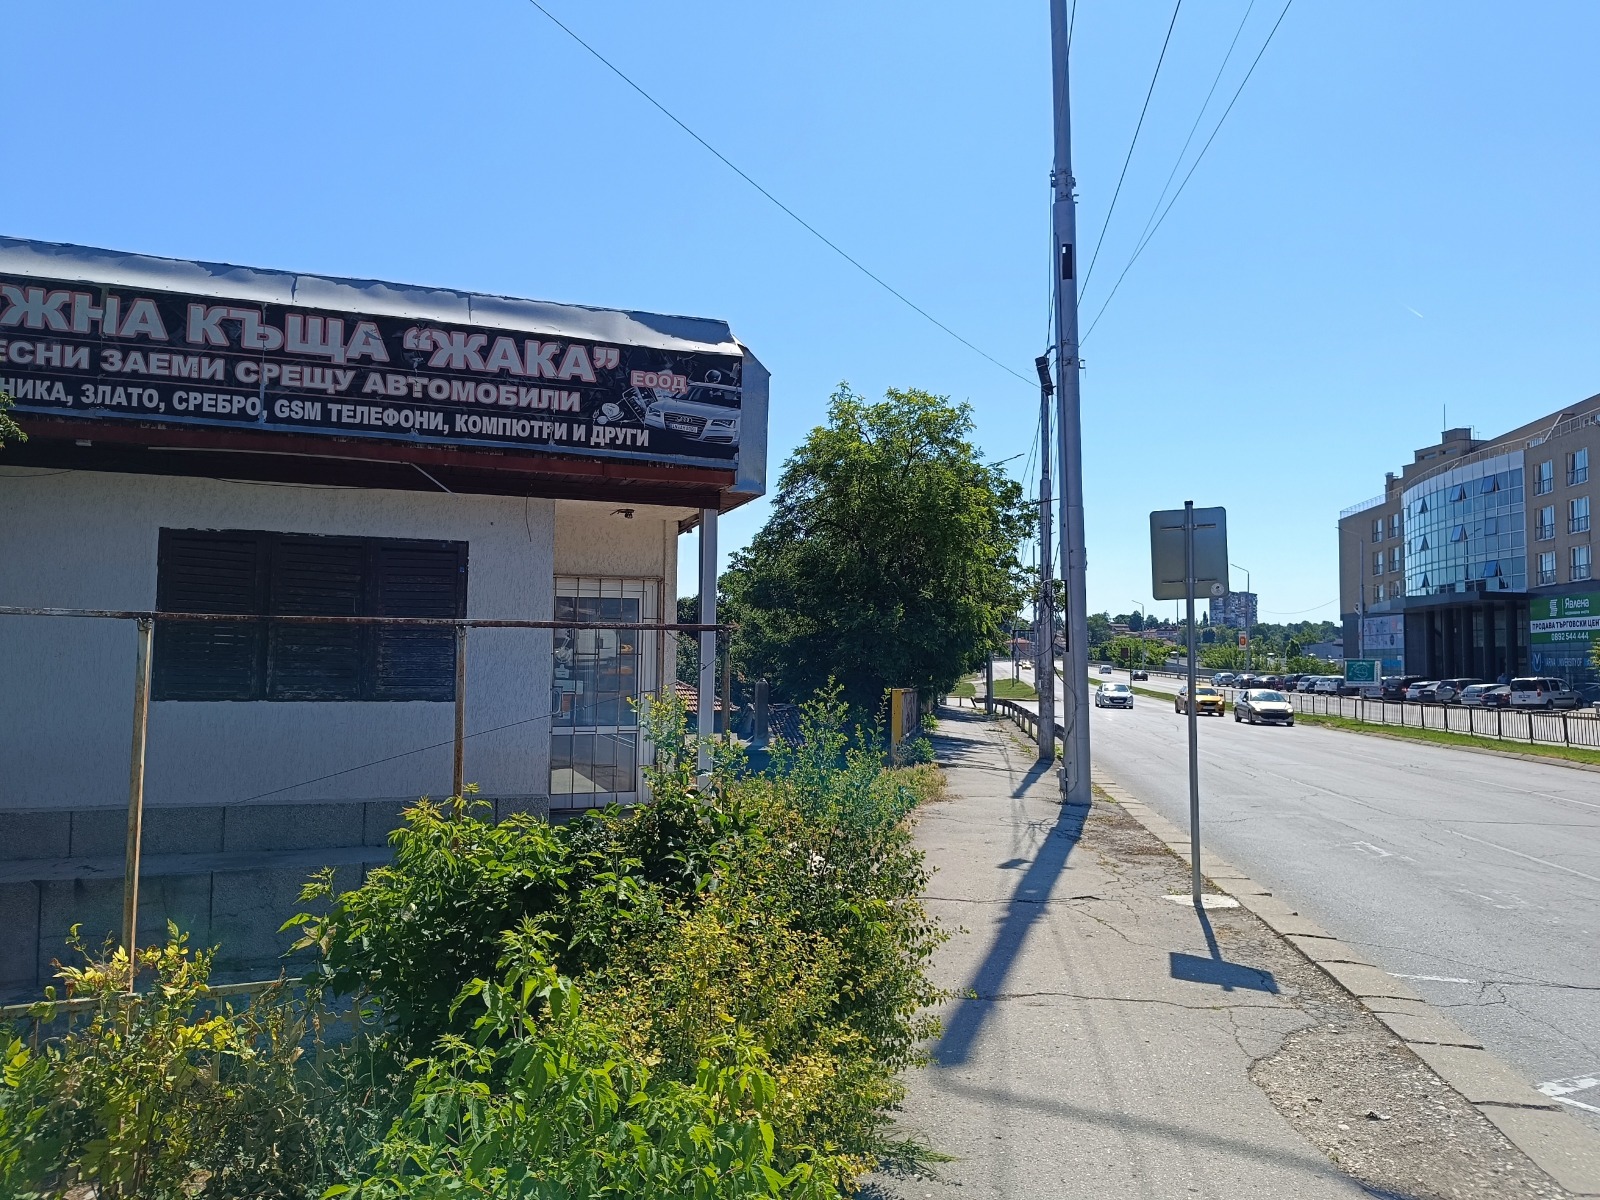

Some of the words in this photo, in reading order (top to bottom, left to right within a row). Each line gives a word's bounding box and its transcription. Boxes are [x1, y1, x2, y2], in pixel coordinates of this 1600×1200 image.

[187, 304, 389, 363] КЪЩА
[100, 349, 225, 381] ЗАЕМИ
[235, 361, 356, 394] СРЕЩУ
[362, 373, 580, 412] АВТОМОБИЛИ
[631, 370, 687, 393] ЕООД
[0, 378, 73, 405] НИКА,
[80, 384, 164, 413] ЗЛАТО,
[172, 391, 267, 418] СРЕБРО,
[274, 399, 321, 421] GSM
[327, 404, 449, 434] ТЕЛЕФОНИ,
[455, 414, 568, 441] КОМПЮТРИ
[572, 423, 586, 442] И
[590, 425, 649, 447] ДРУГИ
[1565, 598, 1589, 609] Явлена
[1556, 620, 1587, 629] ТЪРГОВСКИ
[1565, 632, 1576, 640] 544
[1577, 631, 1588, 640] 444
